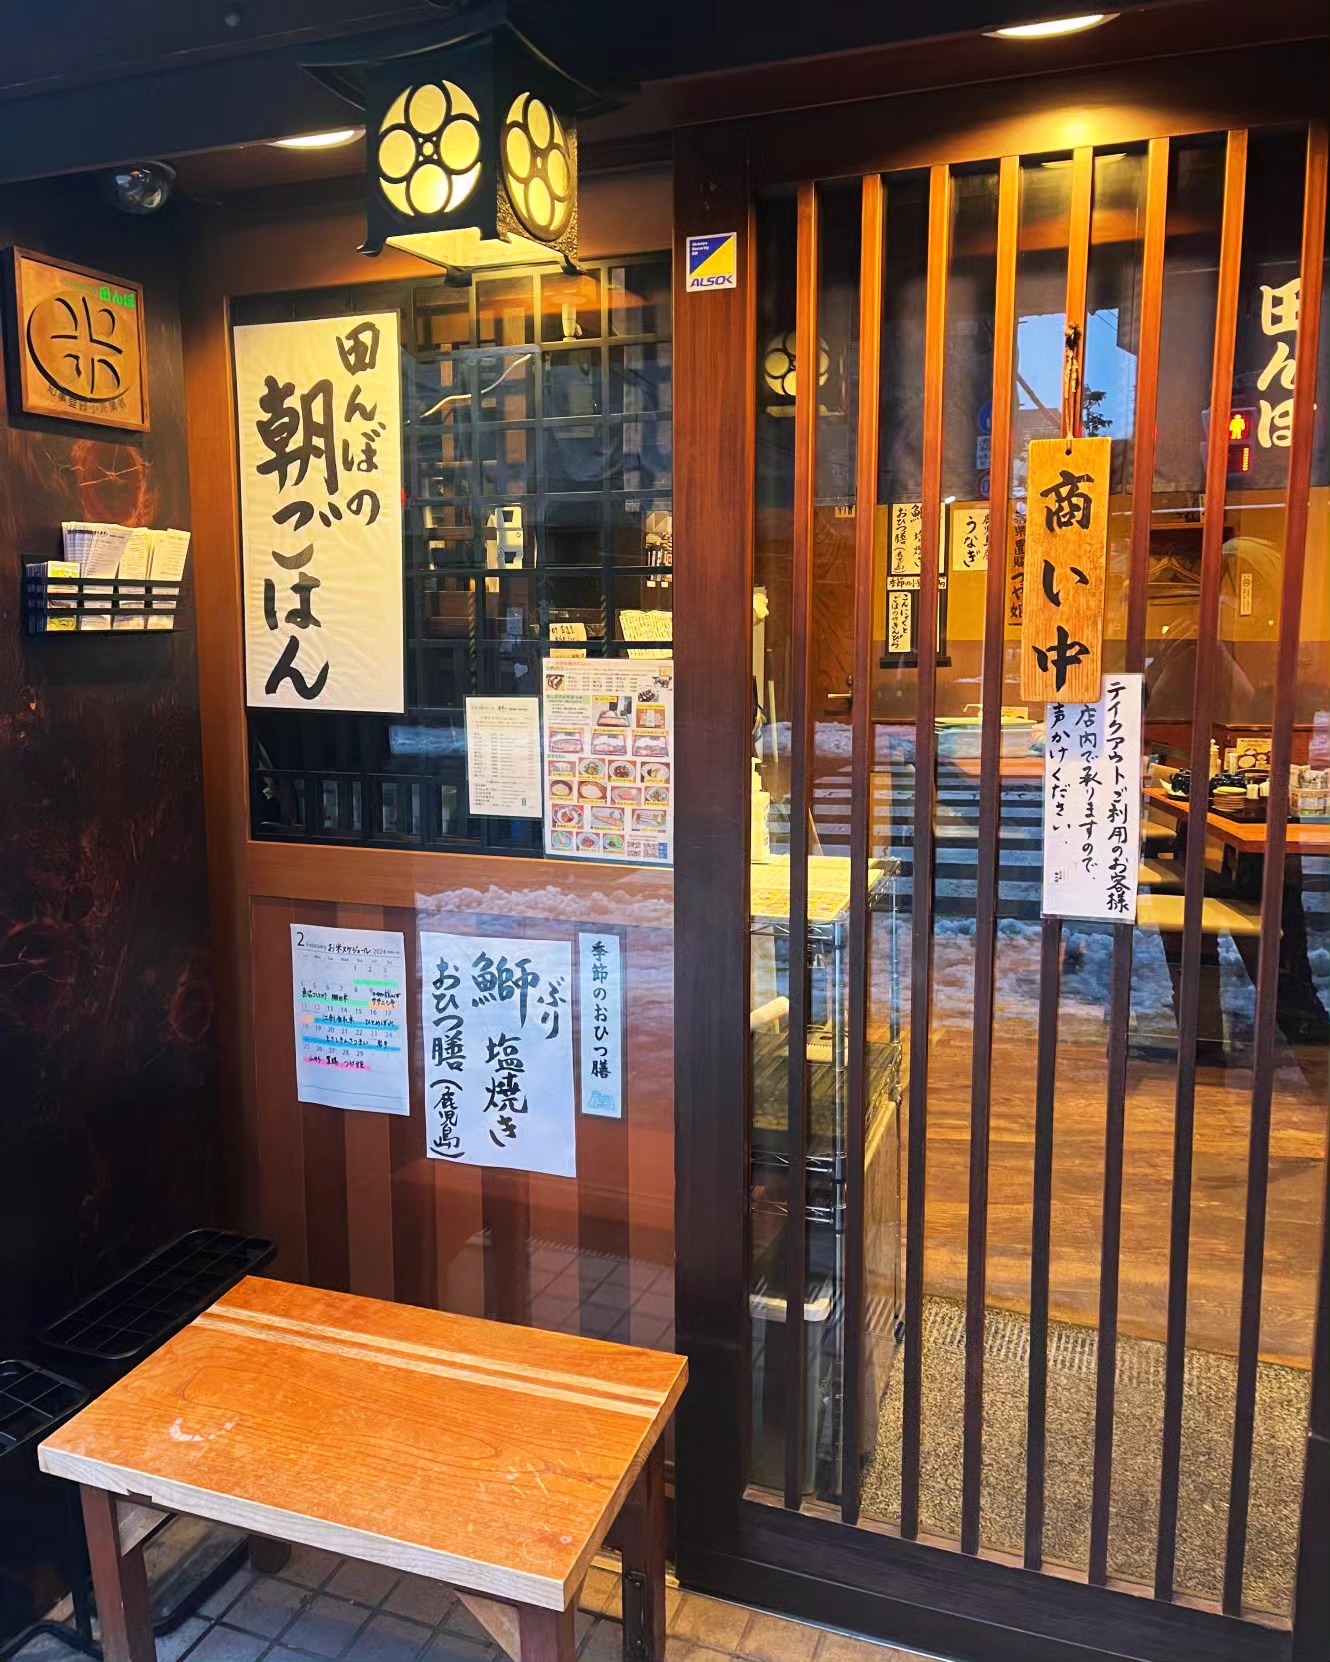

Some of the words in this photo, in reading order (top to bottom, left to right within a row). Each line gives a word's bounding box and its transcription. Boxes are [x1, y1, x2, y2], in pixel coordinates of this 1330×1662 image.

[690, 275, 733, 287] ALSOK
[335, 322, 387, 526] 田んぼの
[255, 375, 343, 701] 朝ごはん
[963, 515, 981, 568] うなぎ
[1031, 470, 1096, 693] 商い中
[1106, 681, 1131, 913] テイクアウトご利用のお客様
[296, 931, 305, 947] 2
[306, 941, 327, 951] February
[537, 975, 567, 1040] ぶり
[591, 941, 612, 1079] 季節のおひつ膳
